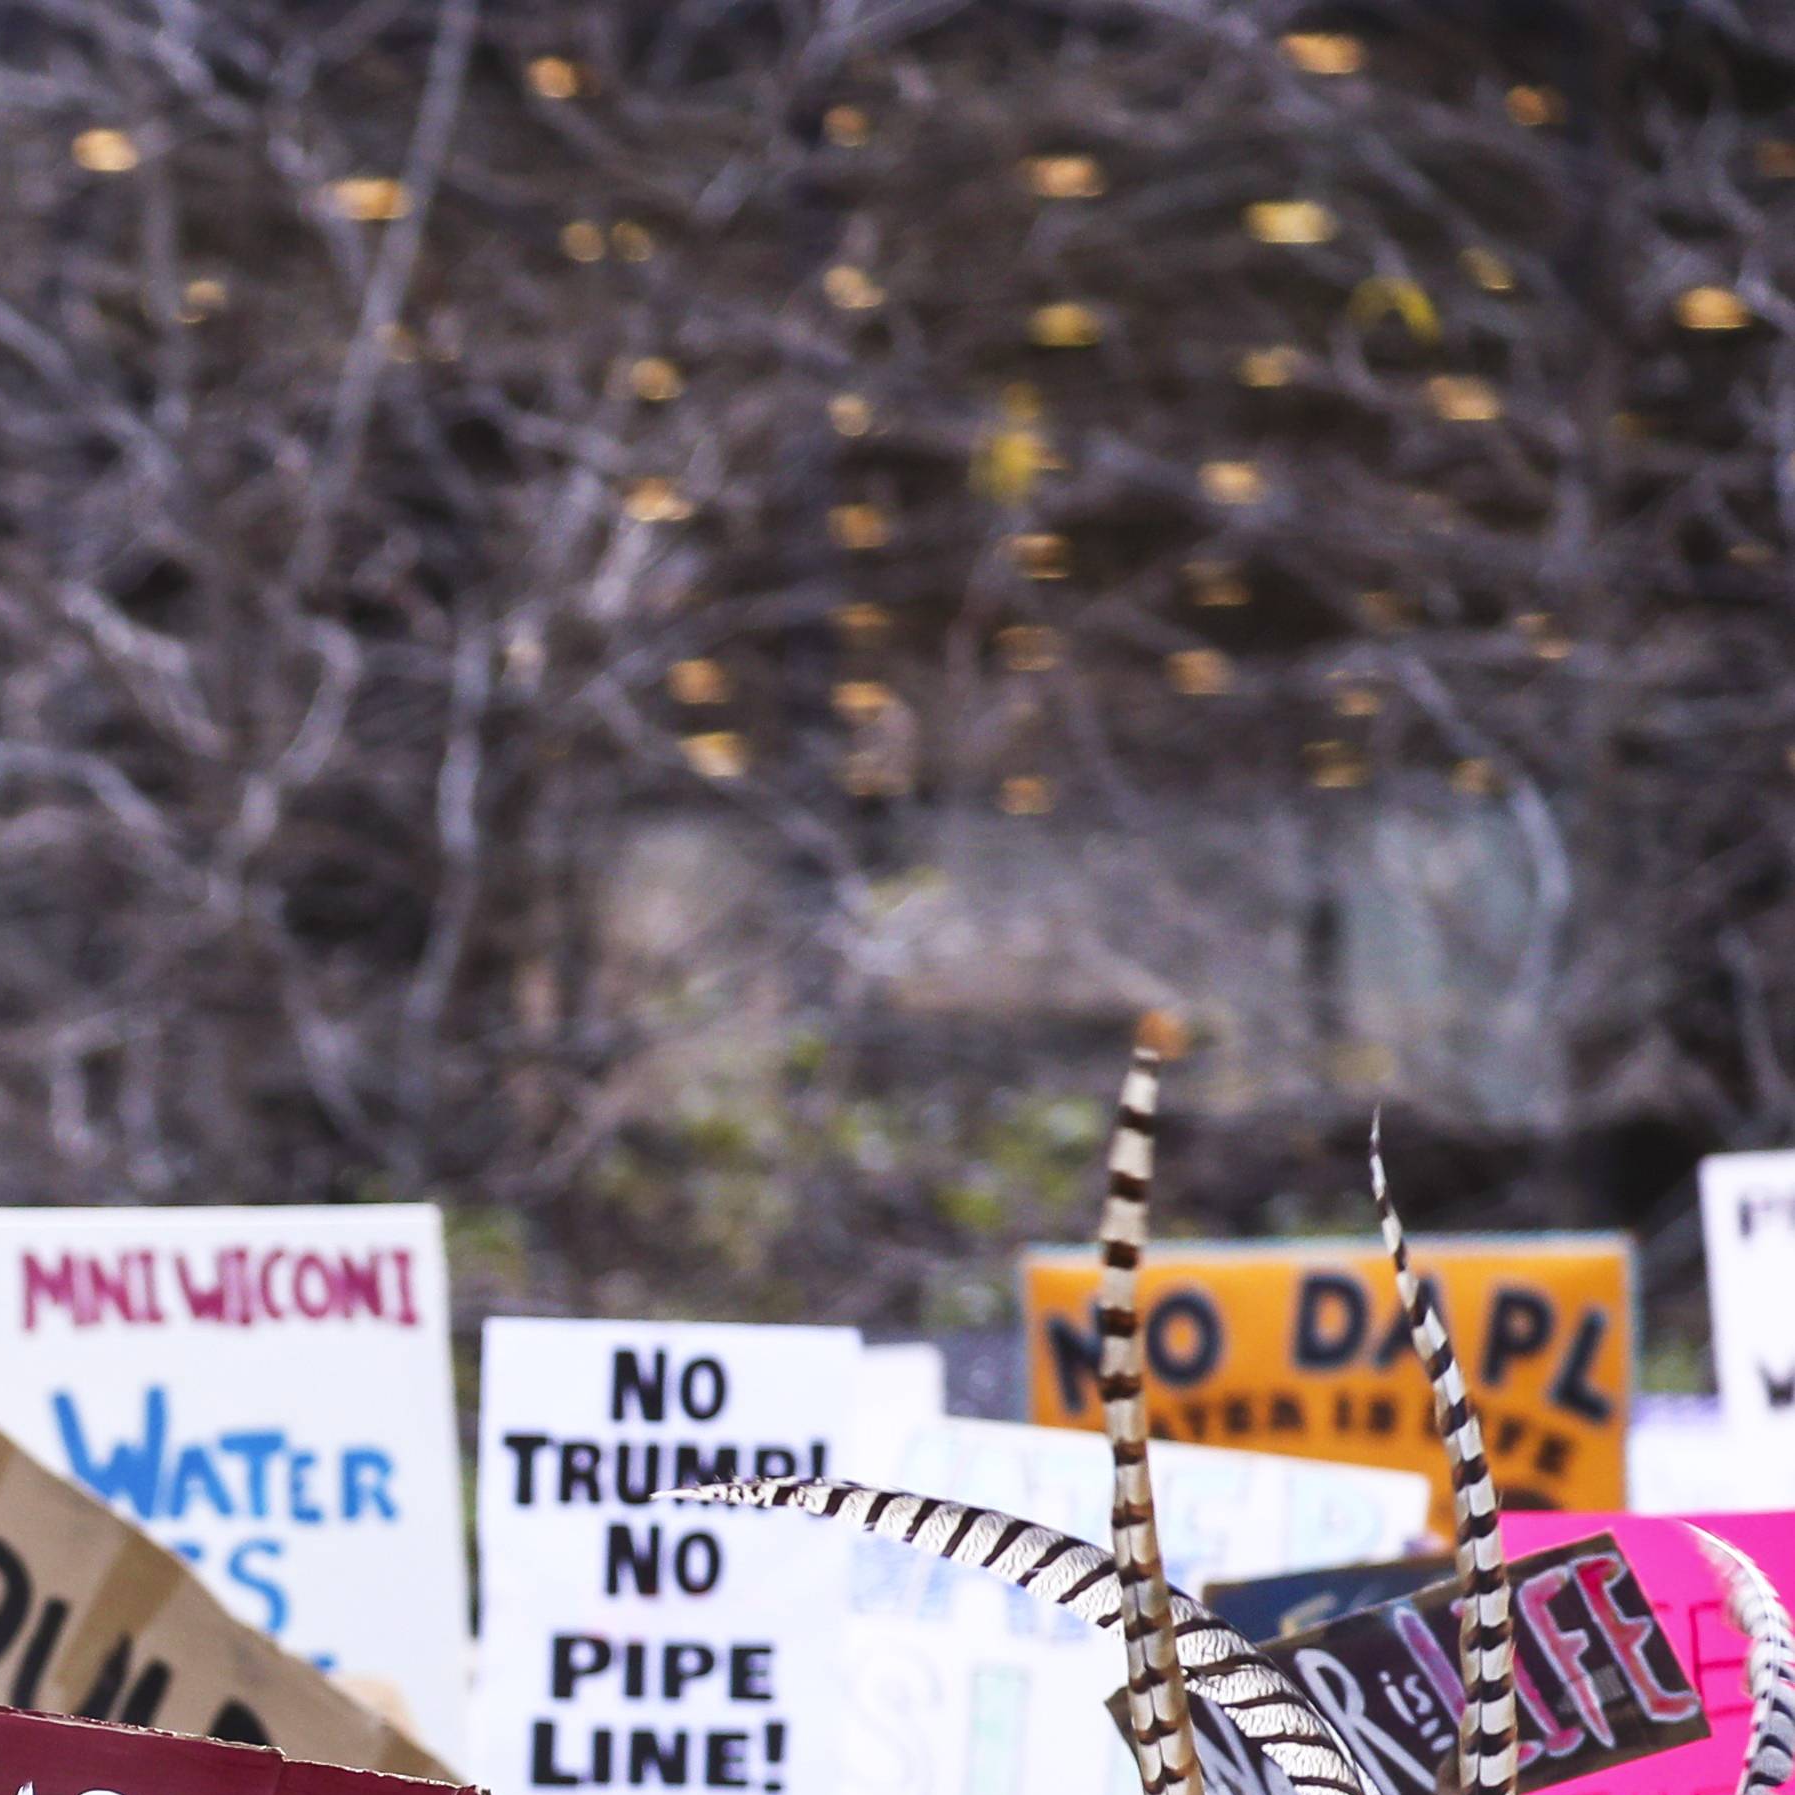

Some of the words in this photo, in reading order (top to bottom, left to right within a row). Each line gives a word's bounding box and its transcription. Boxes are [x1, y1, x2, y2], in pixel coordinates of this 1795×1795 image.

[21, 1248, 165, 1332] MNI
[175, 1246, 421, 1328] WICONI
[611, 1348, 727, 1422] NO
[1045, 1284, 1225, 1414] NO
[1147, 1392, 1307, 1440] ATER
[51, 1385, 399, 1526] WATER
[503, 1435, 831, 1510] TRUMP!
[605, 1522, 723, 1598] NO
[551, 1633, 775, 1702] PIPE
[529, 1719, 788, 1793] LINE!
